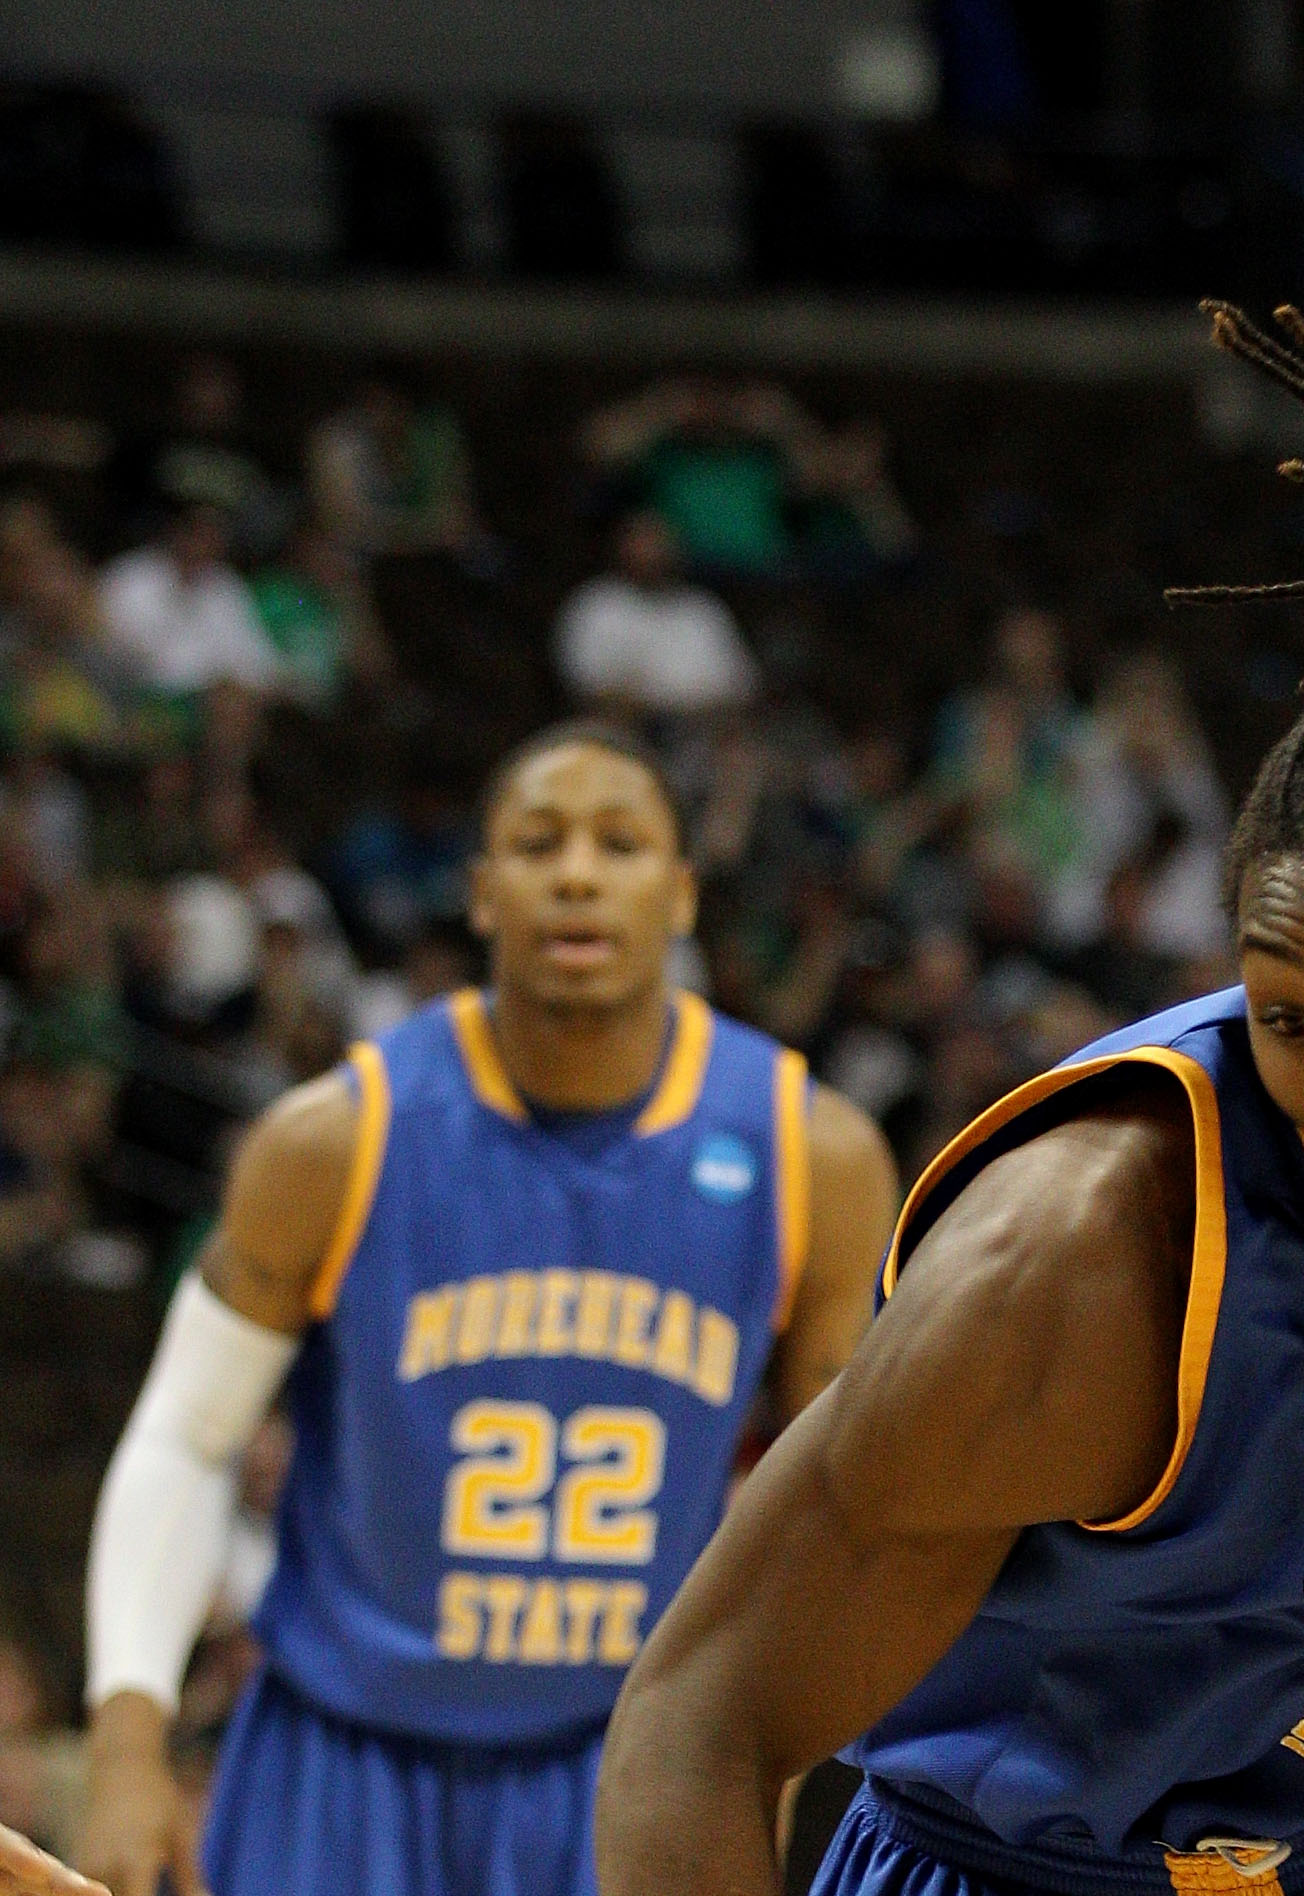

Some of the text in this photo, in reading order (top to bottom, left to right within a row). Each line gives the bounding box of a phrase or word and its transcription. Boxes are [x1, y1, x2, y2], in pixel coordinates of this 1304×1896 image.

[396, 1266, 741, 1407] MOREHEAD
[439, 1398, 667, 1565] 22
[437, 1569, 648, 1666] STATE
